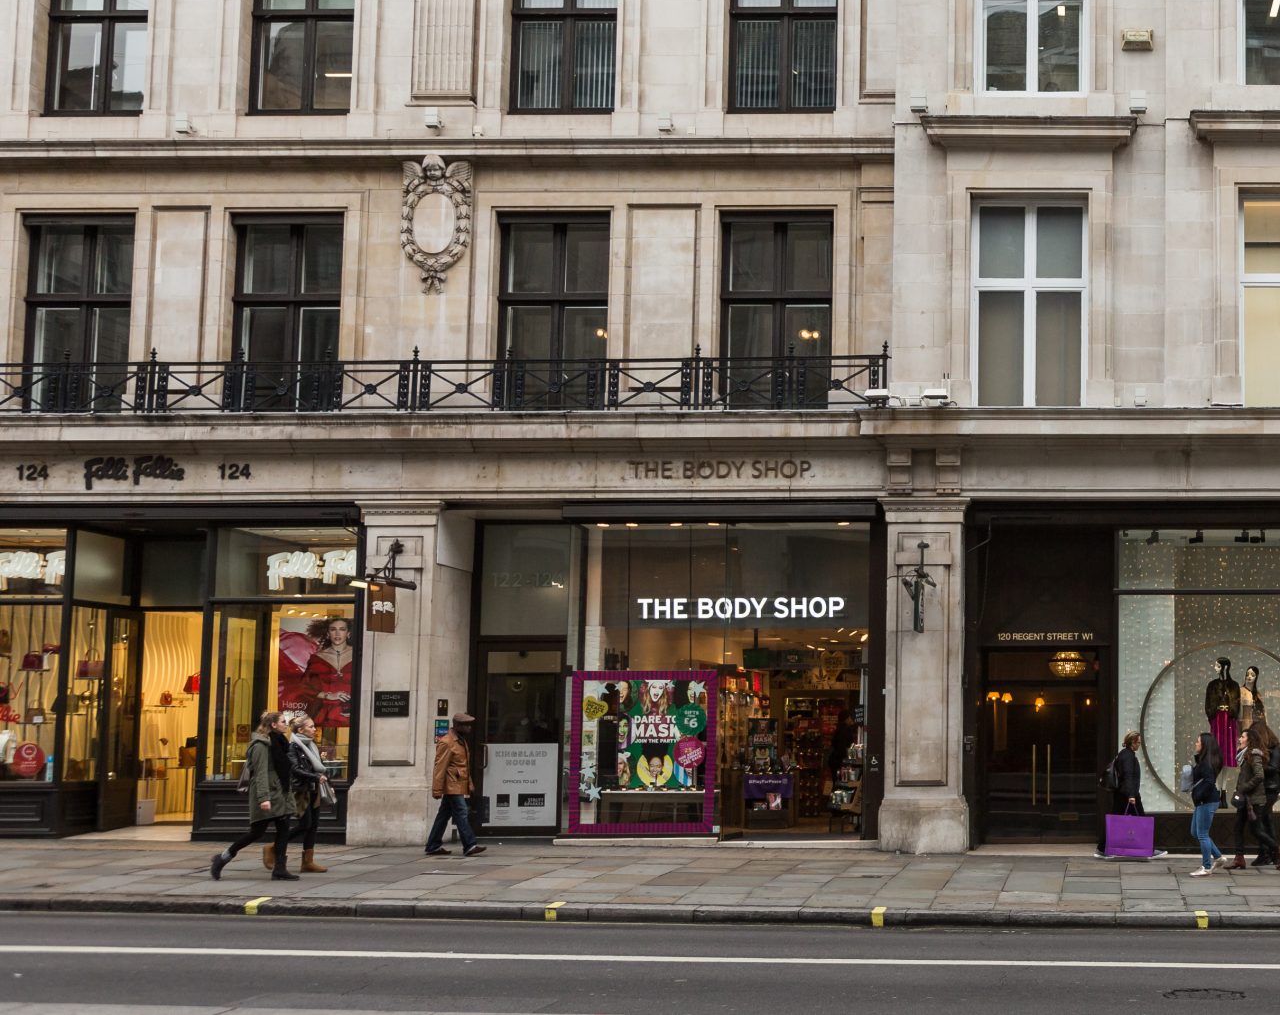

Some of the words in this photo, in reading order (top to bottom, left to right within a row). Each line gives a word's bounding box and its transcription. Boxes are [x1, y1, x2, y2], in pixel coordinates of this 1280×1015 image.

[16, 464, 49, 481] 124
[84, 457, 130, 490] Folli
[133, 455, 185, 485] Follie
[218, 463, 251, 480] 124
[629, 461, 674, 479] THE
[682, 461, 747, 479] BODY
[751, 460, 812, 479] SHOP
[638, 598, 688, 619] THE
[697, 598, 768, 619] BODY
[774, 597, 845, 619] SHOP
[997, 632, 1011, 641] 120
[1012, 632, 1045, 641] REGENT
[1046, 632, 1079, 641] STREET
[1081, 632, 1093, 641] W1
[282, 700, 308, 710] Happy
[634, 715, 662, 724] DARE
[684, 717, 698, 728] £6
[632, 723, 681, 738] MASK
[495, 750, 548, 758] KINGSLAND
